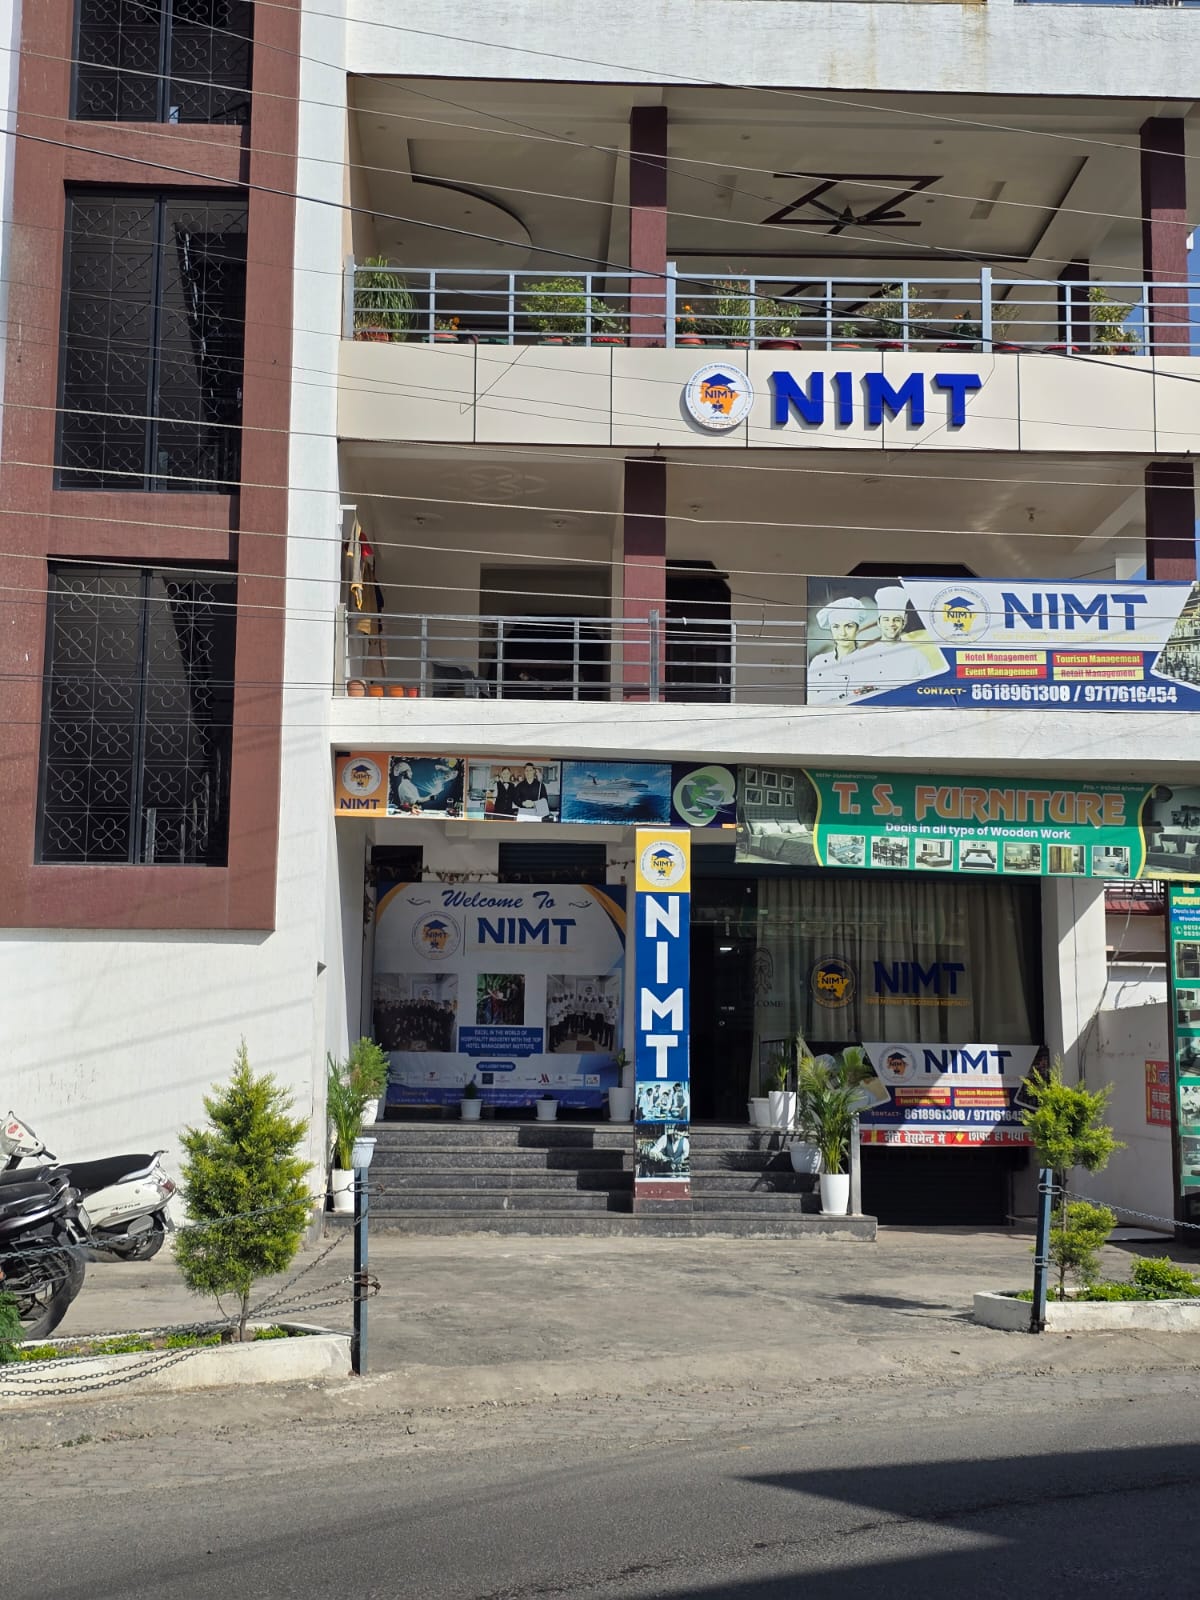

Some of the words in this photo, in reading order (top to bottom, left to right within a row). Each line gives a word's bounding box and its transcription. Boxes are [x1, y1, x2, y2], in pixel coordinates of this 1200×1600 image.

[705, 390, 735, 398] NIMT
[772, 371, 982, 427] NIMT
[1001, 593, 1148, 630] NIMT
[965, 653, 985, 661] Hotel
[987, 653, 1037, 663] Management
[1056, 655, 1088, 663] Tourism
[1089, 655, 1140, 664] Management
[987, 668, 1038, 676] Management
[1085, 670, 1136, 678] Management
[1084, 685, 1178, 703] 9717616454
[340, 798, 380, 809] NIMT
[832, 782, 861, 815] T.
[872, 784, 903, 816] S.
[915, 785, 1126, 829] FURNITURE
[885, 822, 917, 833] Deals
[919, 823, 930, 833] in
[932, 824, 946, 834] all
[949, 825, 975, 837] type
[977, 826, 988, 836] of
[990, 827, 1038, 838] Wooden
[1041, 829, 1071, 839] Work
[441, 890, 523, 908] Welcome
[532, 891, 556, 910] To
[477, 917, 577, 944] NIMT
[640, 895, 683, 1078] NIMT
[873, 961, 965, 994] NIMT
[922, 1049, 1012, 1074] NIMT
[973, 1109, 1024, 1122] 971761645
